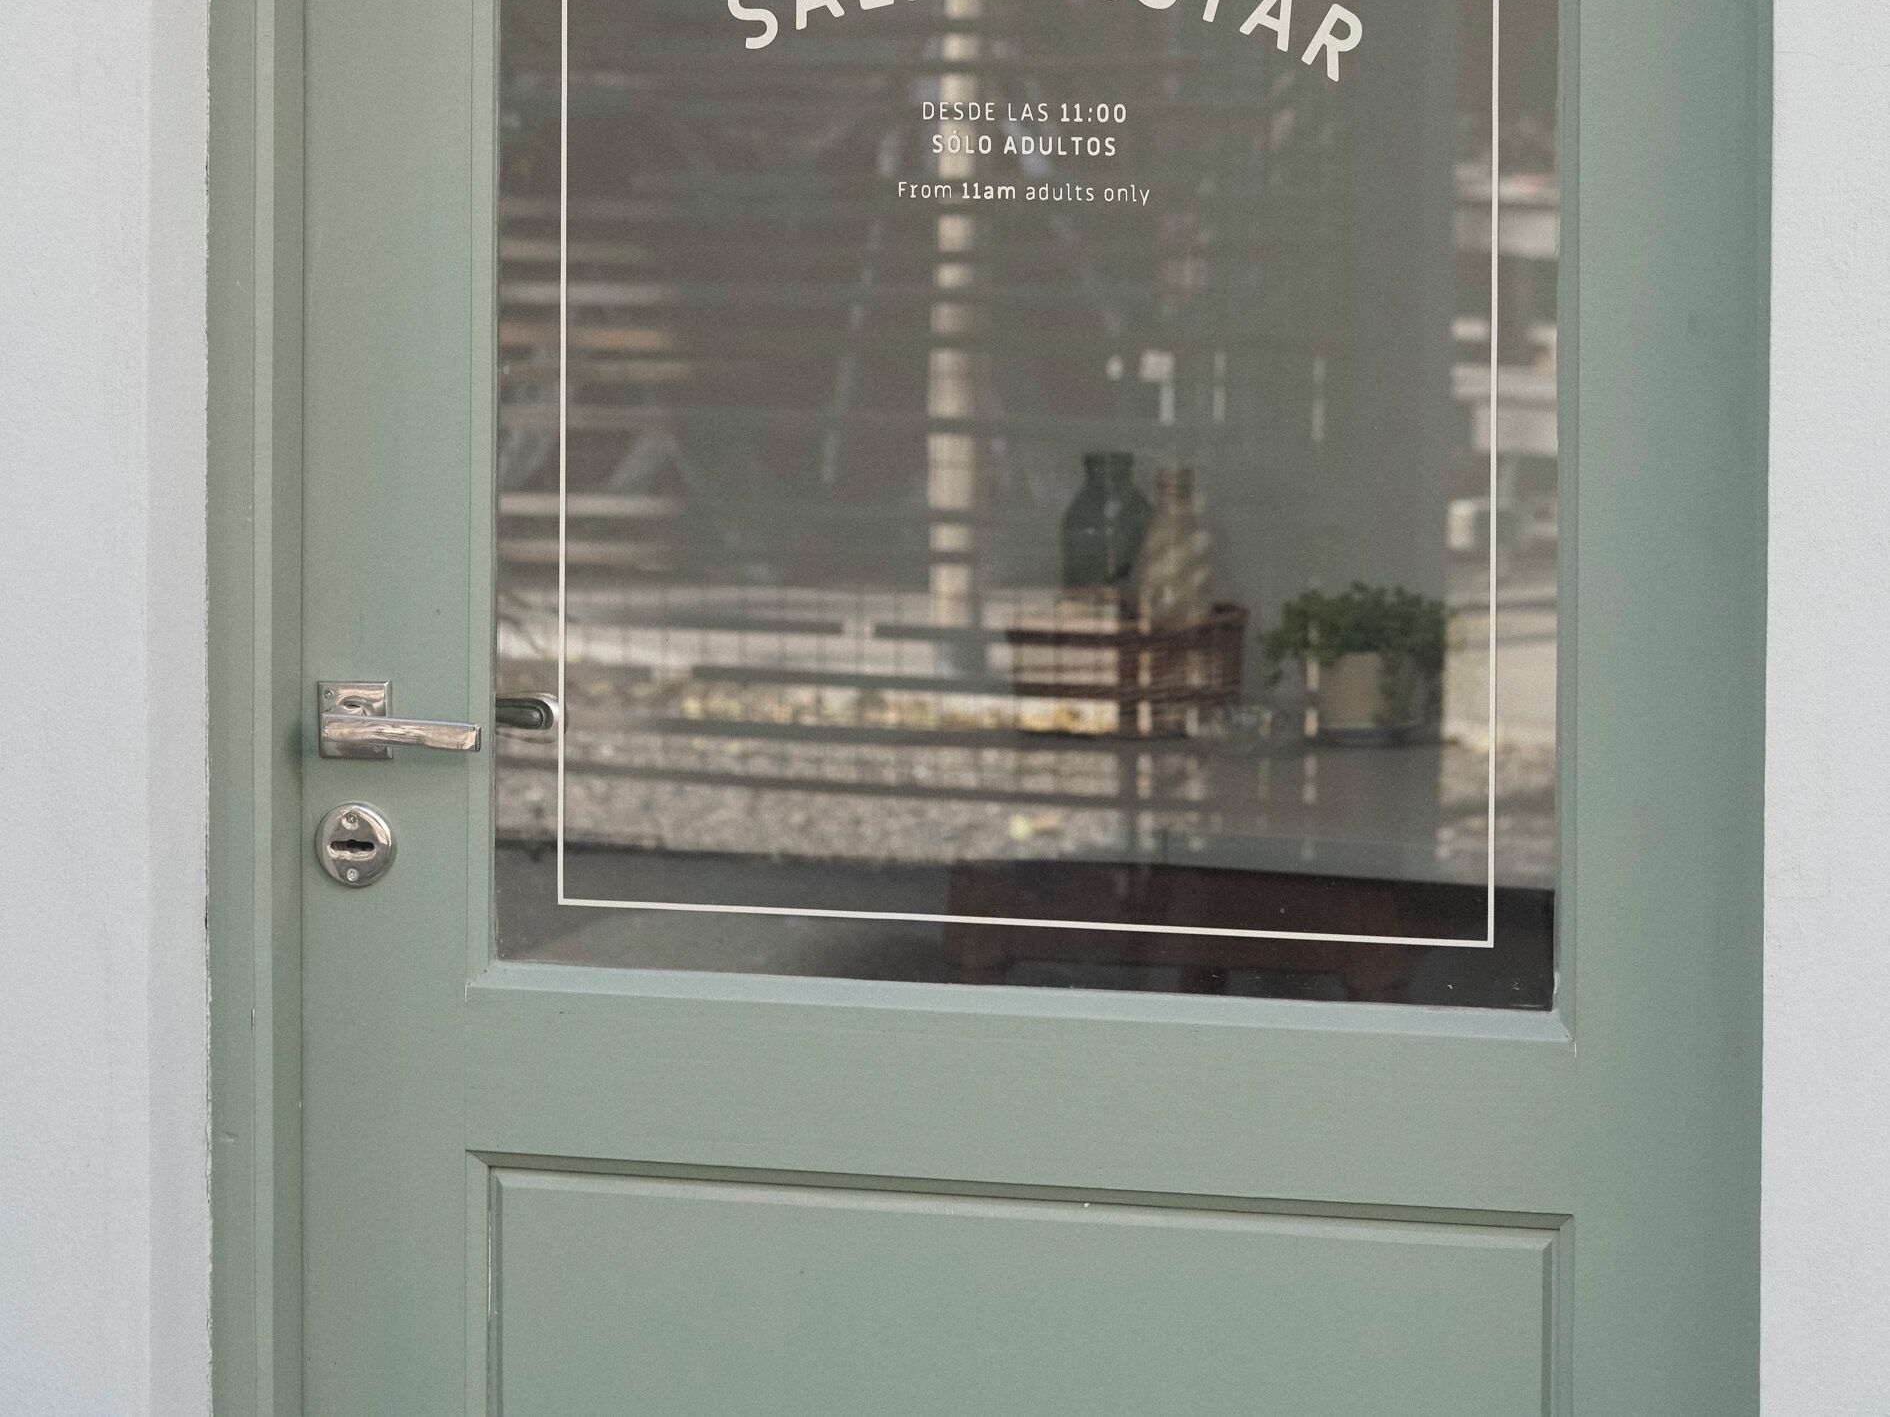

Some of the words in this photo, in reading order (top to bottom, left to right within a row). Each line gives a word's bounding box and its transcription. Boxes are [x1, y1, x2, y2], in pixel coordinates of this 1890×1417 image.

[922, 101, 995, 121] DESDE
[1007, 102, 1049, 122] LAS
[1060, 103, 1127, 123] 11:00
[932, 130, 992, 154] SÓLO
[1003, 136, 1116, 156] ADULTOS
[898, 181, 952, 199] From
[961, 182, 1016, 200] 11am
[1025, 183, 1094, 202] adults
[1103, 184, 1150, 207] only
